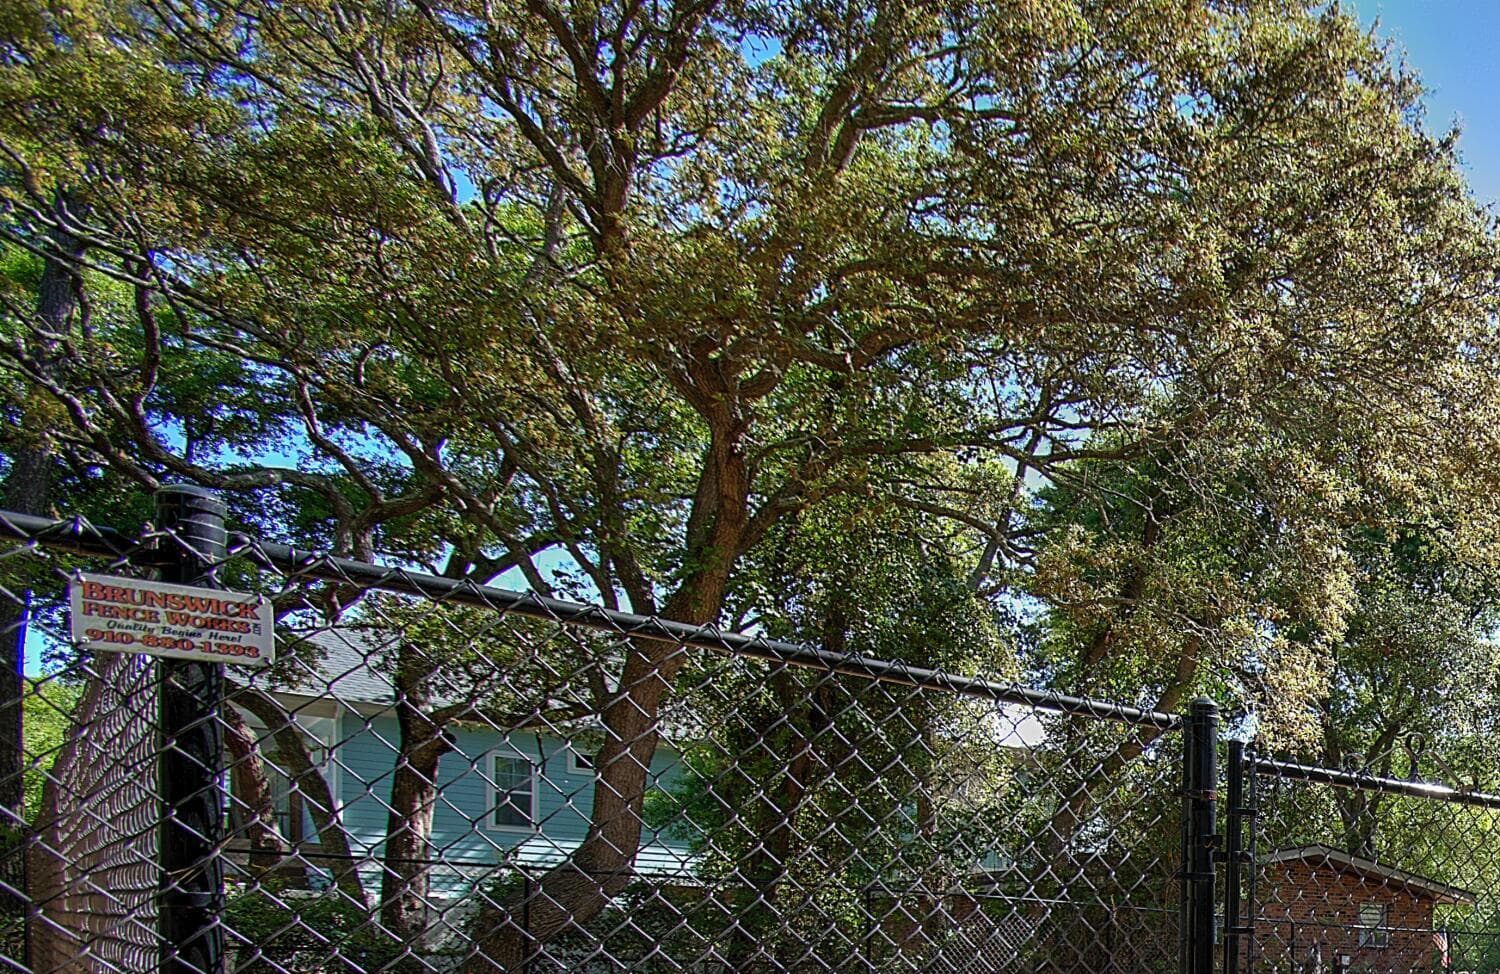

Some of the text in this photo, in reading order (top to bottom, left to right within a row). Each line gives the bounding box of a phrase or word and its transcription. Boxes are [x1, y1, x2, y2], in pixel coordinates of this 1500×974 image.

[82, 581, 261, 620] BRUNSWICK
[82, 601, 161, 623] FENCE
[165, 611, 251, 634] WORKS
[106, 620, 243, 643] Quality Begins Here!
